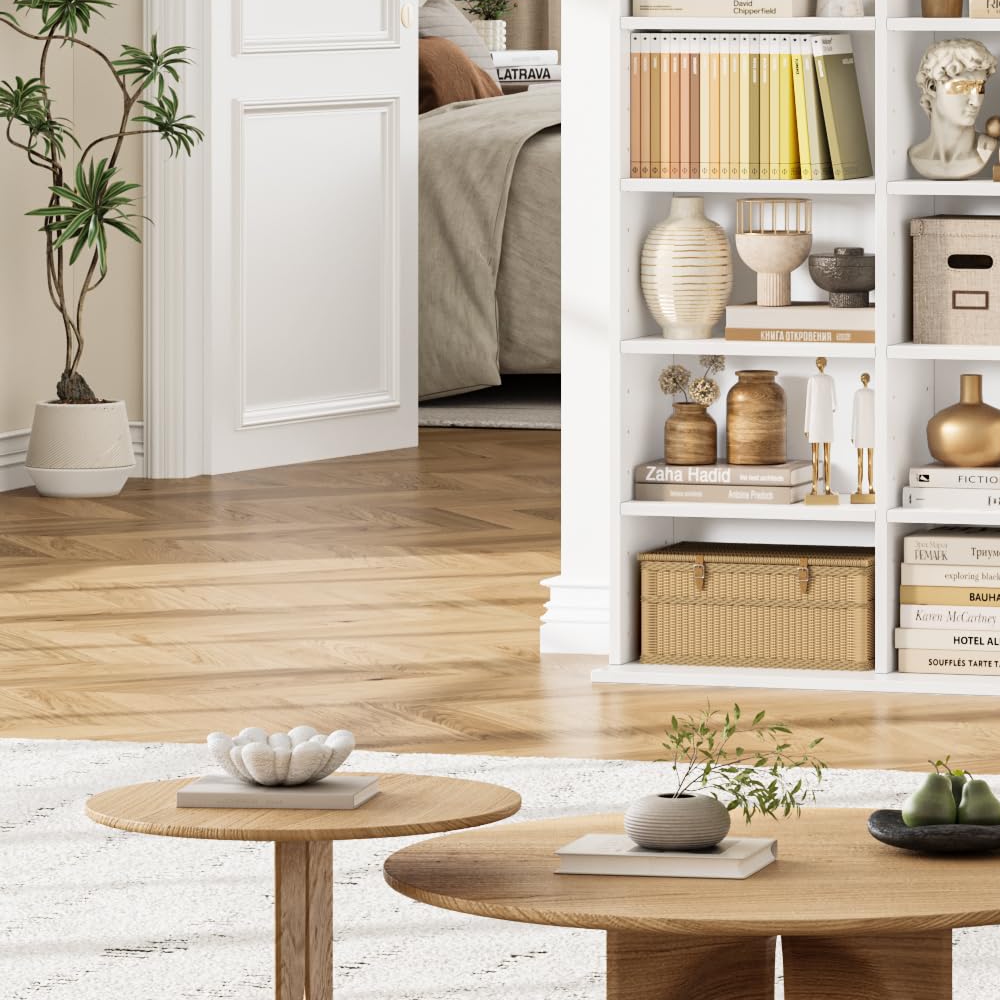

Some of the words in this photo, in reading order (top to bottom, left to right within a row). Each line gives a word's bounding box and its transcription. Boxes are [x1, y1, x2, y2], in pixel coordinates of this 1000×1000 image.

[760, 331, 784, 340] КНИГА
[786, 331, 832, 342] ОТКРОВЕНИЯ
[646, 466, 683, 482] Zaha
[688, 468, 730, 482] Hadid
[944, 573, 979, 582] exploring
[981, 572, 1000, 581] black
[915, 610, 943, 622] Karen
[946, 611, 997, 625] McCartney
[953, 636, 984, 646] HOTEL
[928, 657, 966, 667] SOUFFLÉS
[968, 659, 992, 668] TARTE
